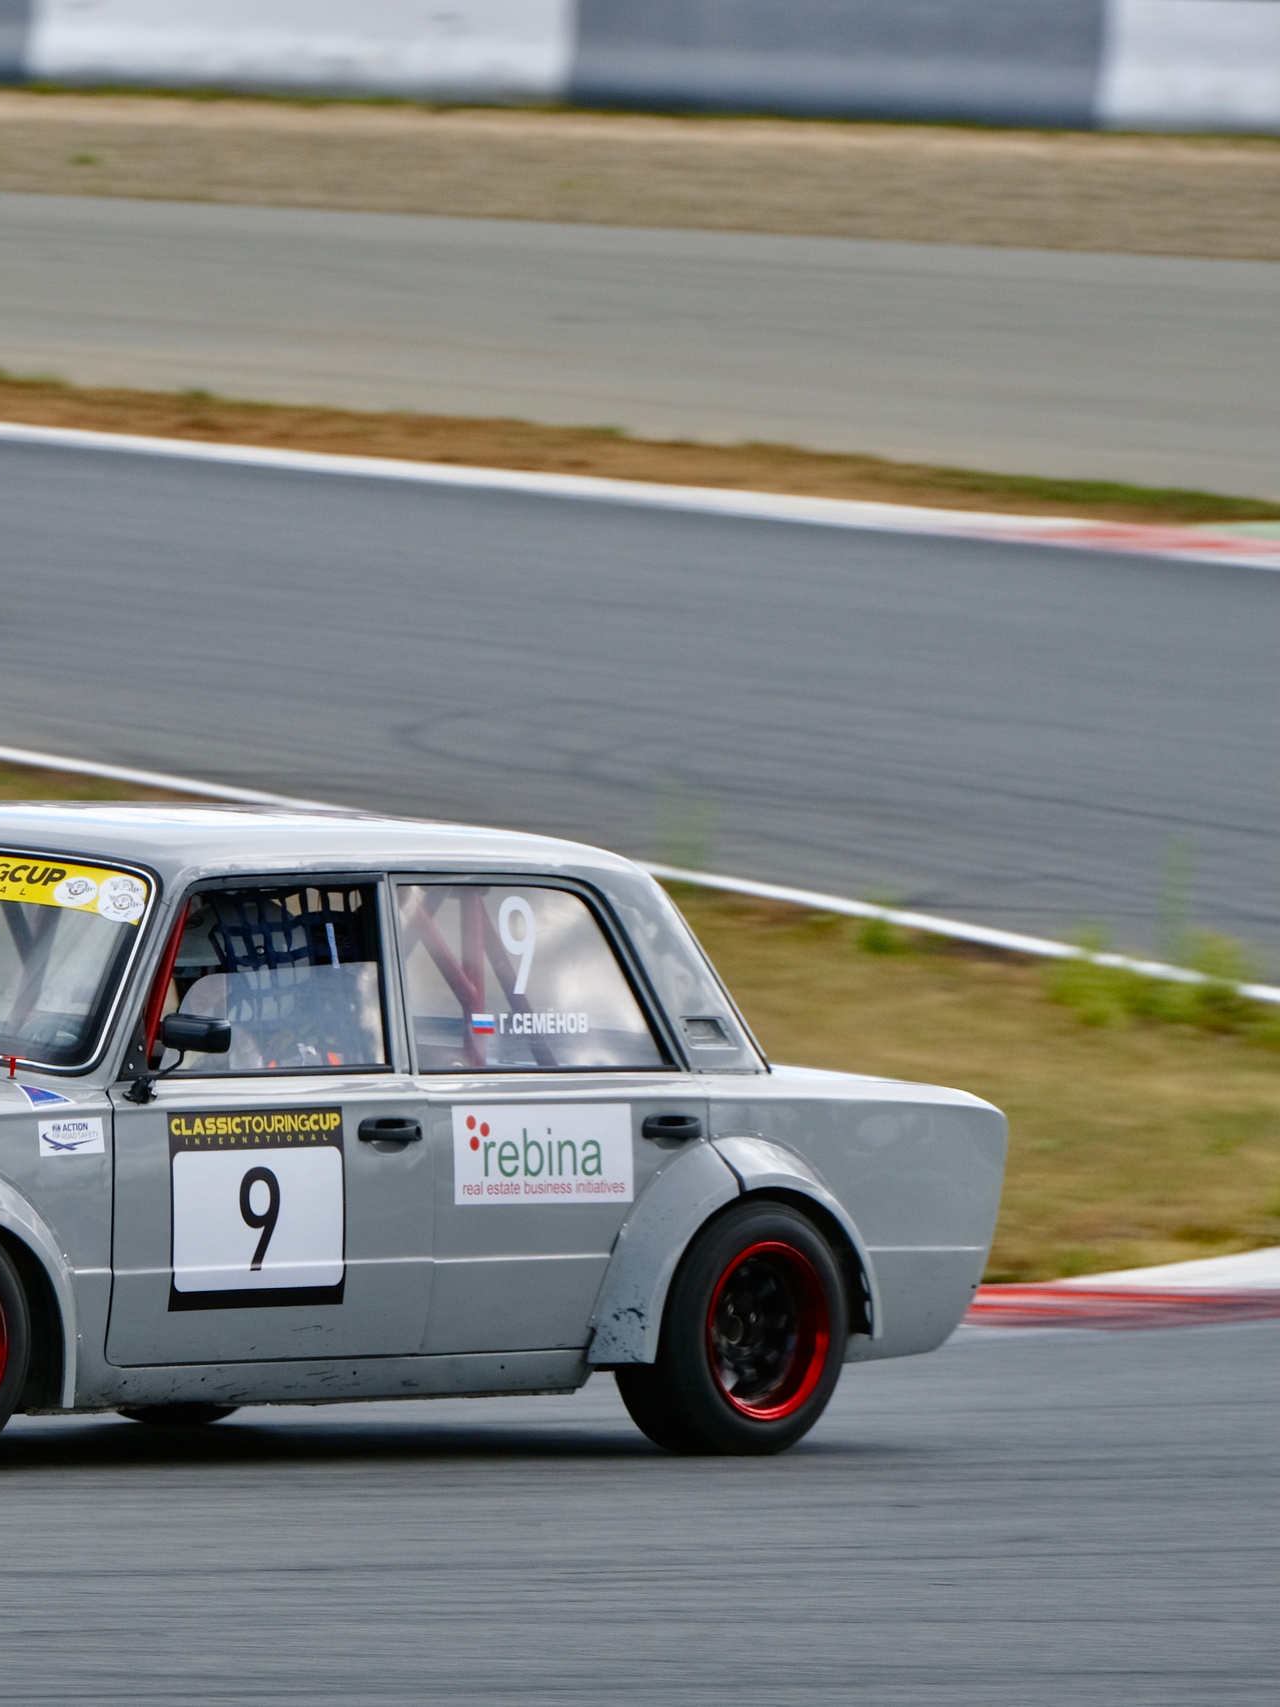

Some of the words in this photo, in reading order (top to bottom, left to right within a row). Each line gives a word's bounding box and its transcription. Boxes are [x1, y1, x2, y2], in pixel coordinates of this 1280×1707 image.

[498, 896, 536, 995] 9
[61, 1131, 77, 1139] ROAD
[78, 1131, 99, 1139] SAFETY
[63, 1123, 88, 1131] ACTION
[185, 1133, 329, 1145] INTERNATIONAL
[482, 1128, 602, 1178] rebina
[463, 1181, 483, 1195] real
[486, 1181, 520, 1195] estate
[524, 1180, 572, 1194] business
[576, 1179, 625, 1194] initiatives
[239, 1166, 280, 1271] 9
